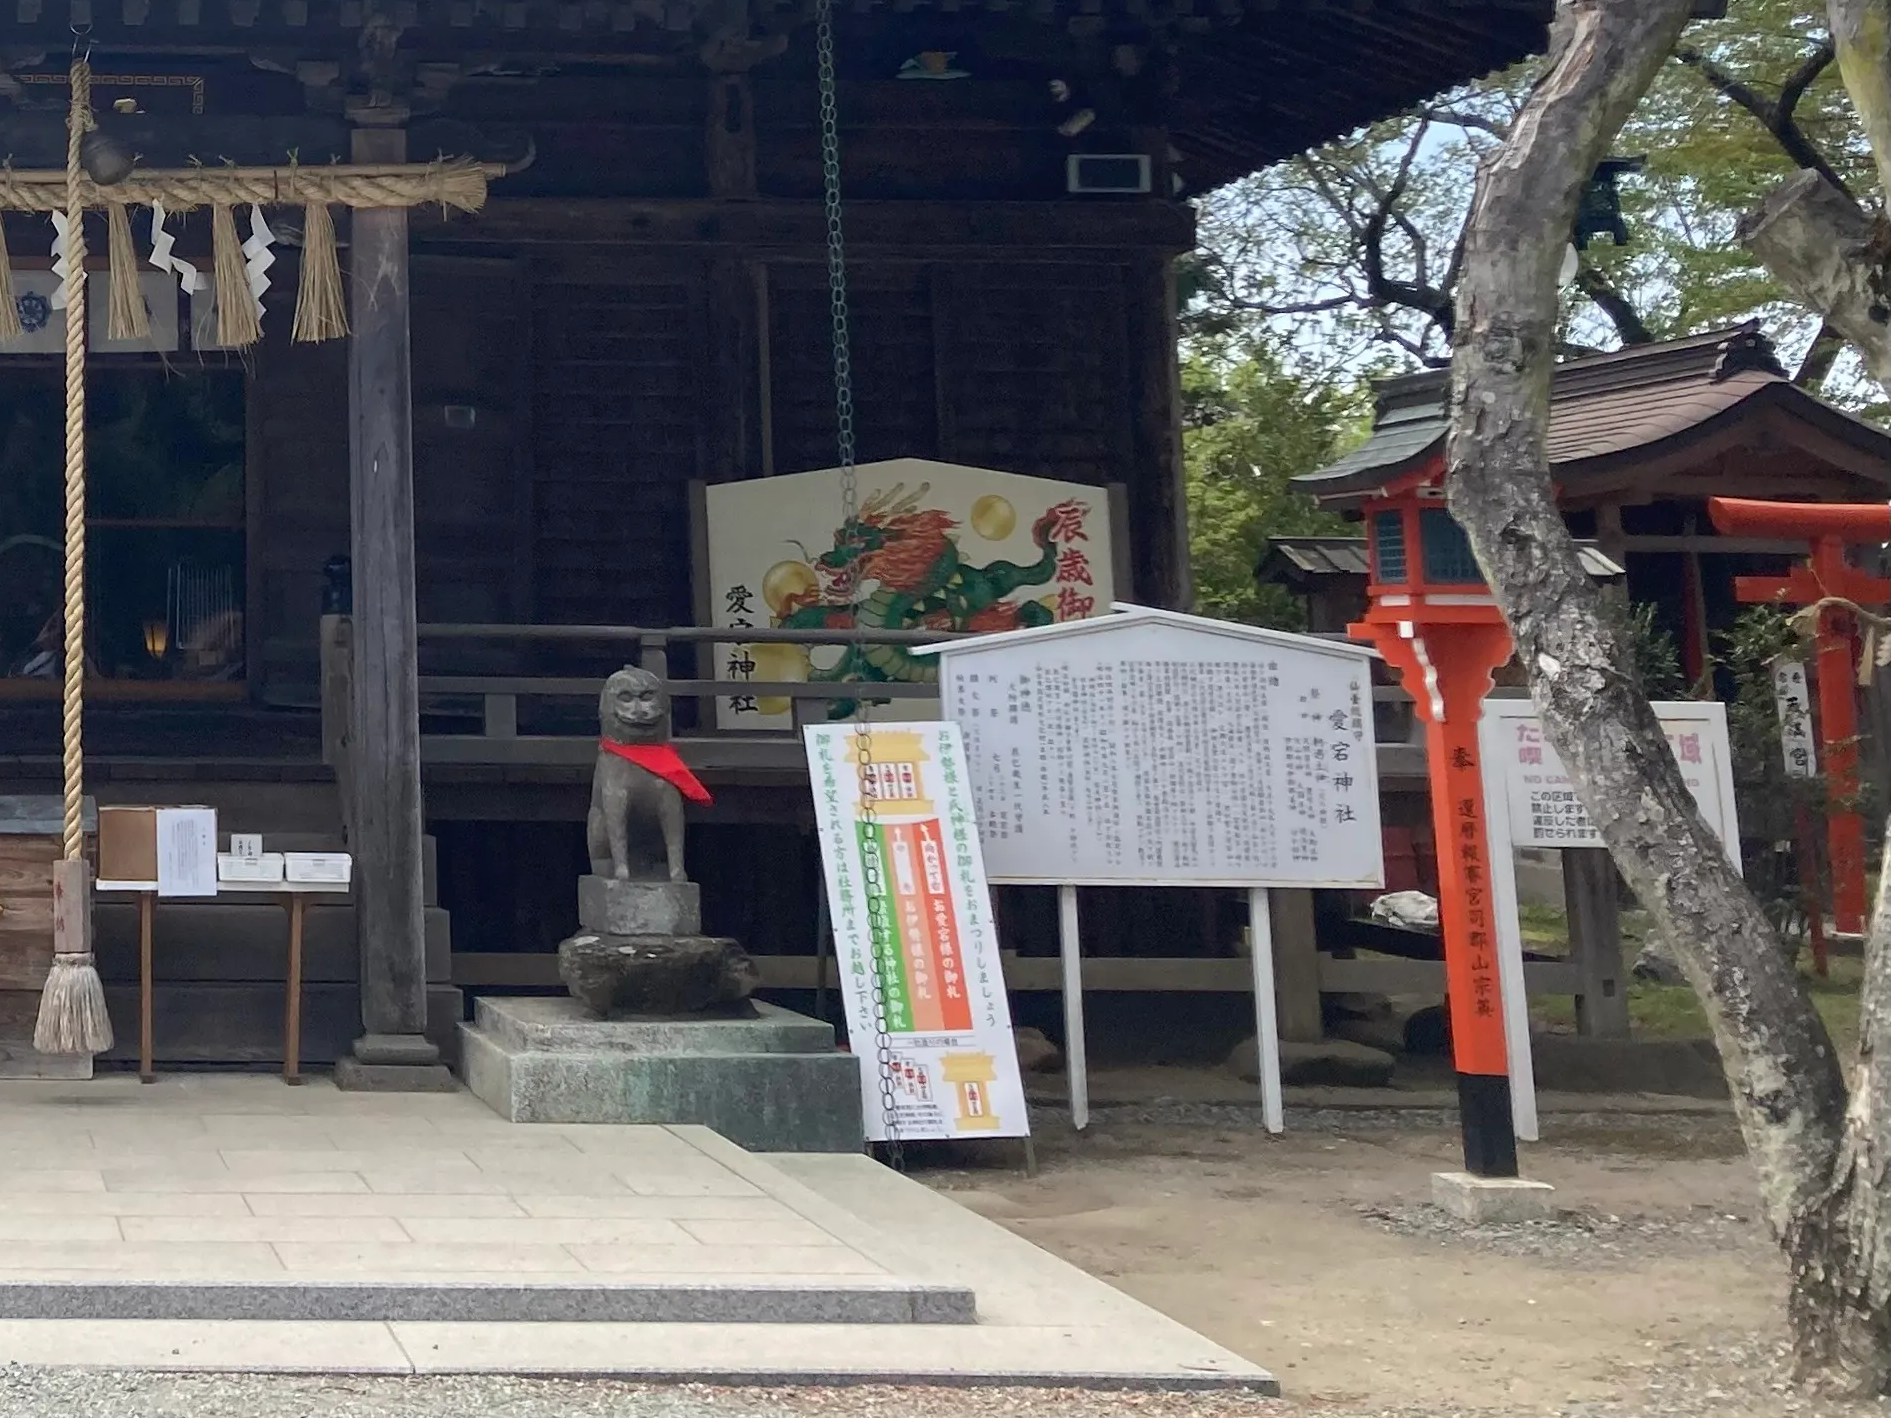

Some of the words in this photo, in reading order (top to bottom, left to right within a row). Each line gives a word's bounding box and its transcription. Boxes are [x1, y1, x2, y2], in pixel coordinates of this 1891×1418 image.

[1328, 709, 1357, 824] 愛宕神社
[1531, 790, 1578, 801] この区域
